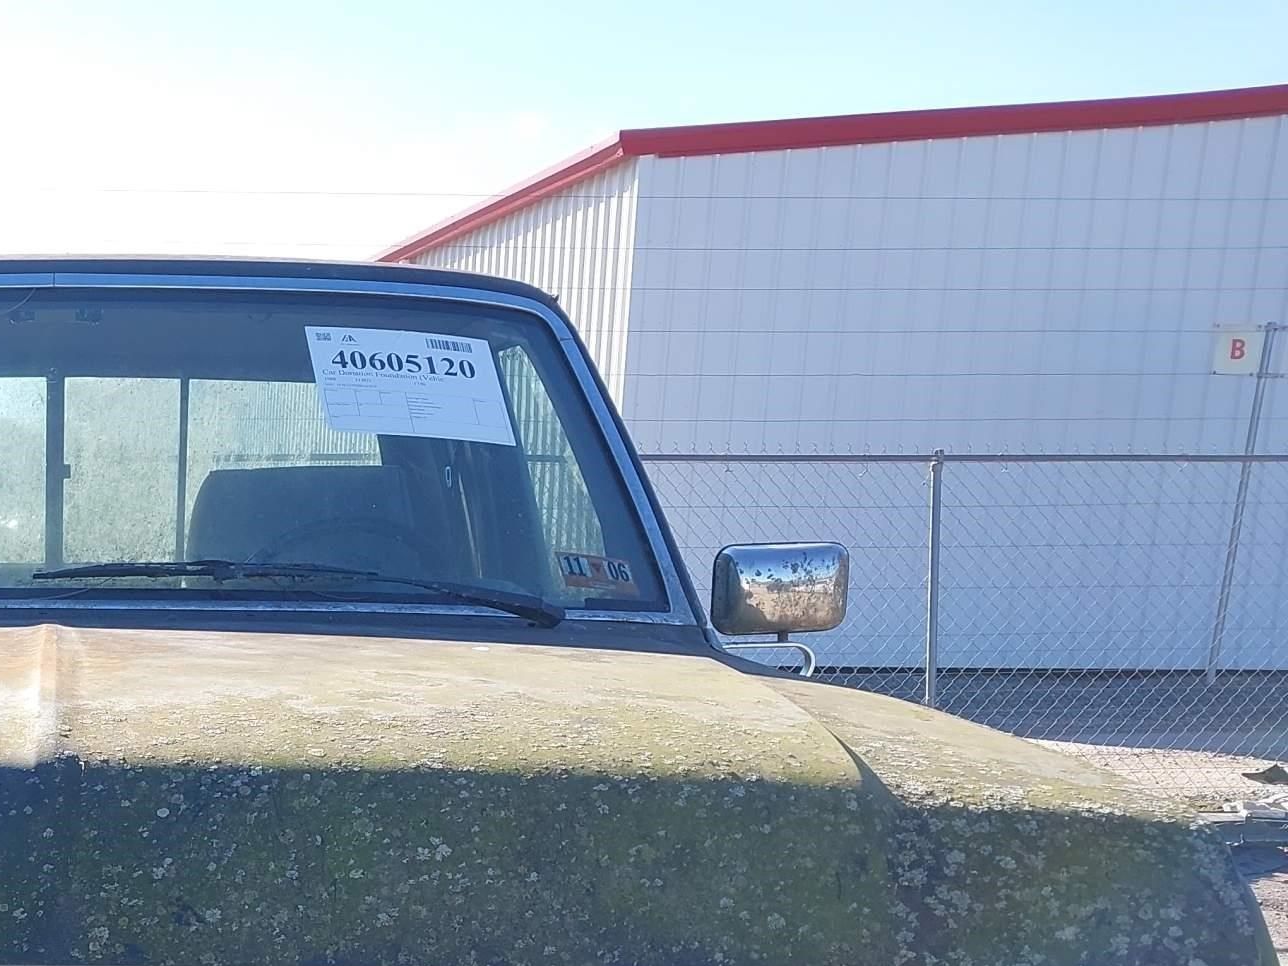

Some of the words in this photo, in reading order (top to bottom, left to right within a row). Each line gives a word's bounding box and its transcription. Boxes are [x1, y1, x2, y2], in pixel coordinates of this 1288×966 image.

[1230, 338, 1246, 360] B
[331, 350, 476, 379] 40605120
[375, 371, 418, 380] Foundation
[563, 556, 587, 577] 11
[607, 561, 630, 582] 06
